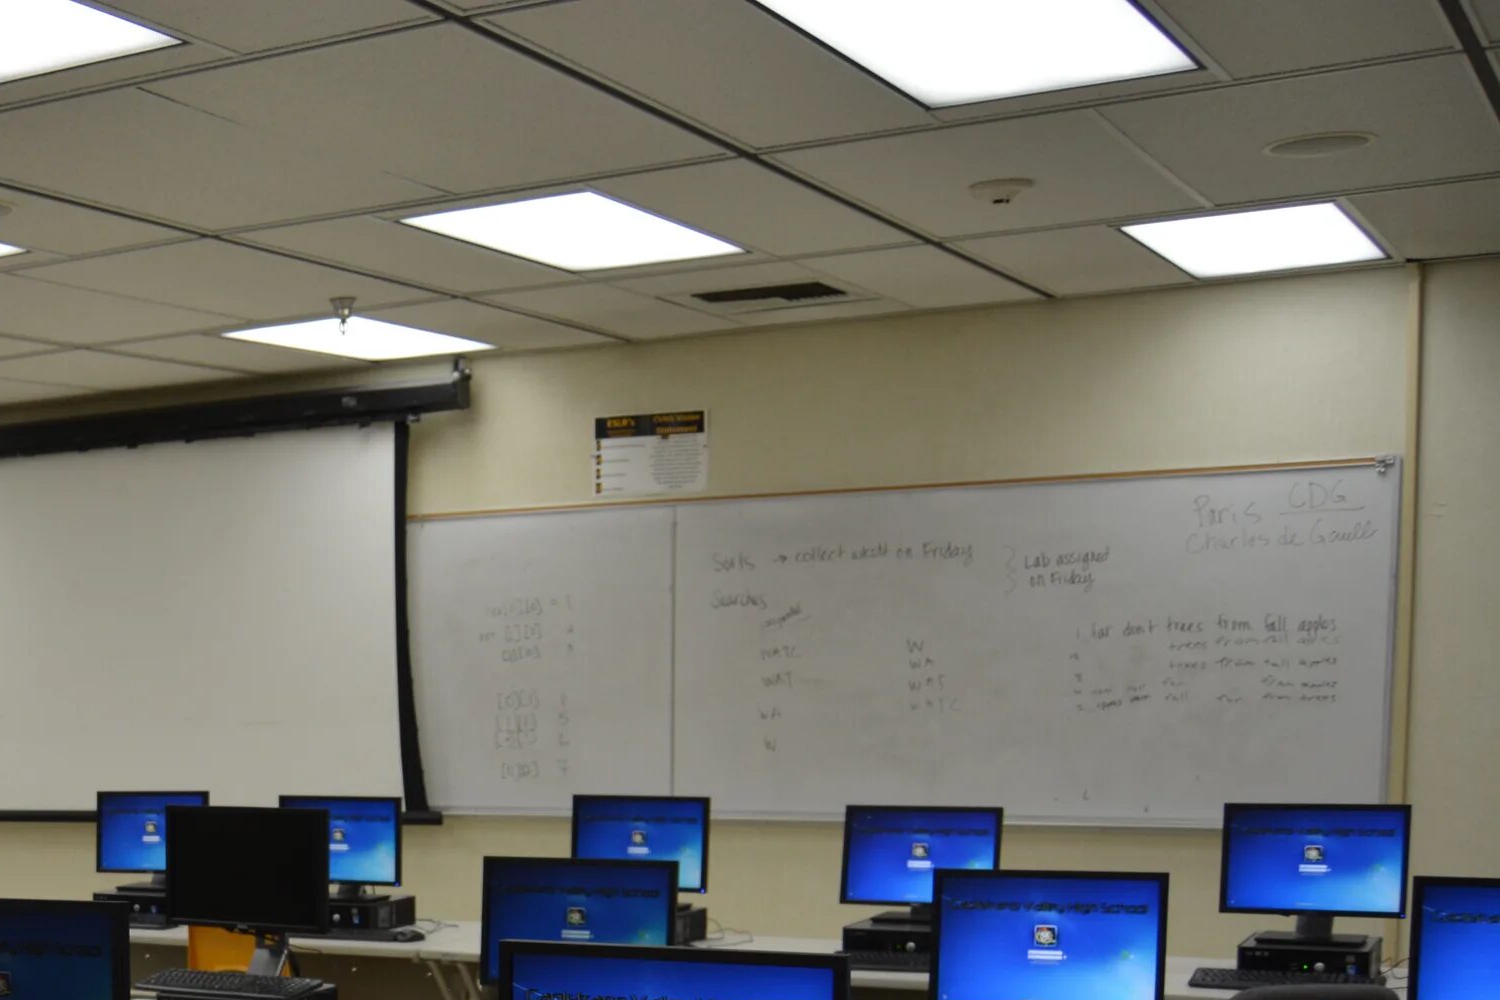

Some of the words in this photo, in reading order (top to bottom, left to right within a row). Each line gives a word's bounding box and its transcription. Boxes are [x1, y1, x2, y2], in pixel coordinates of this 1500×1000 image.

[1192, 494, 1261, 529] Paris
[1288, 480, 1348, 509] CDG
[794, 543, 845, 563] collect
[896, 546, 913, 560] on
[921, 540, 973, 568] Friday
[1186, 529, 1270, 554] Charles
[1277, 528, 1304, 548] de
[1024, 550, 1052, 570] Lab
[1055, 545, 1112, 573] assigned
[1028, 572, 1048, 588] on
[1049, 568, 1096, 593] Friday
[1166, 615, 1205, 634] trees
